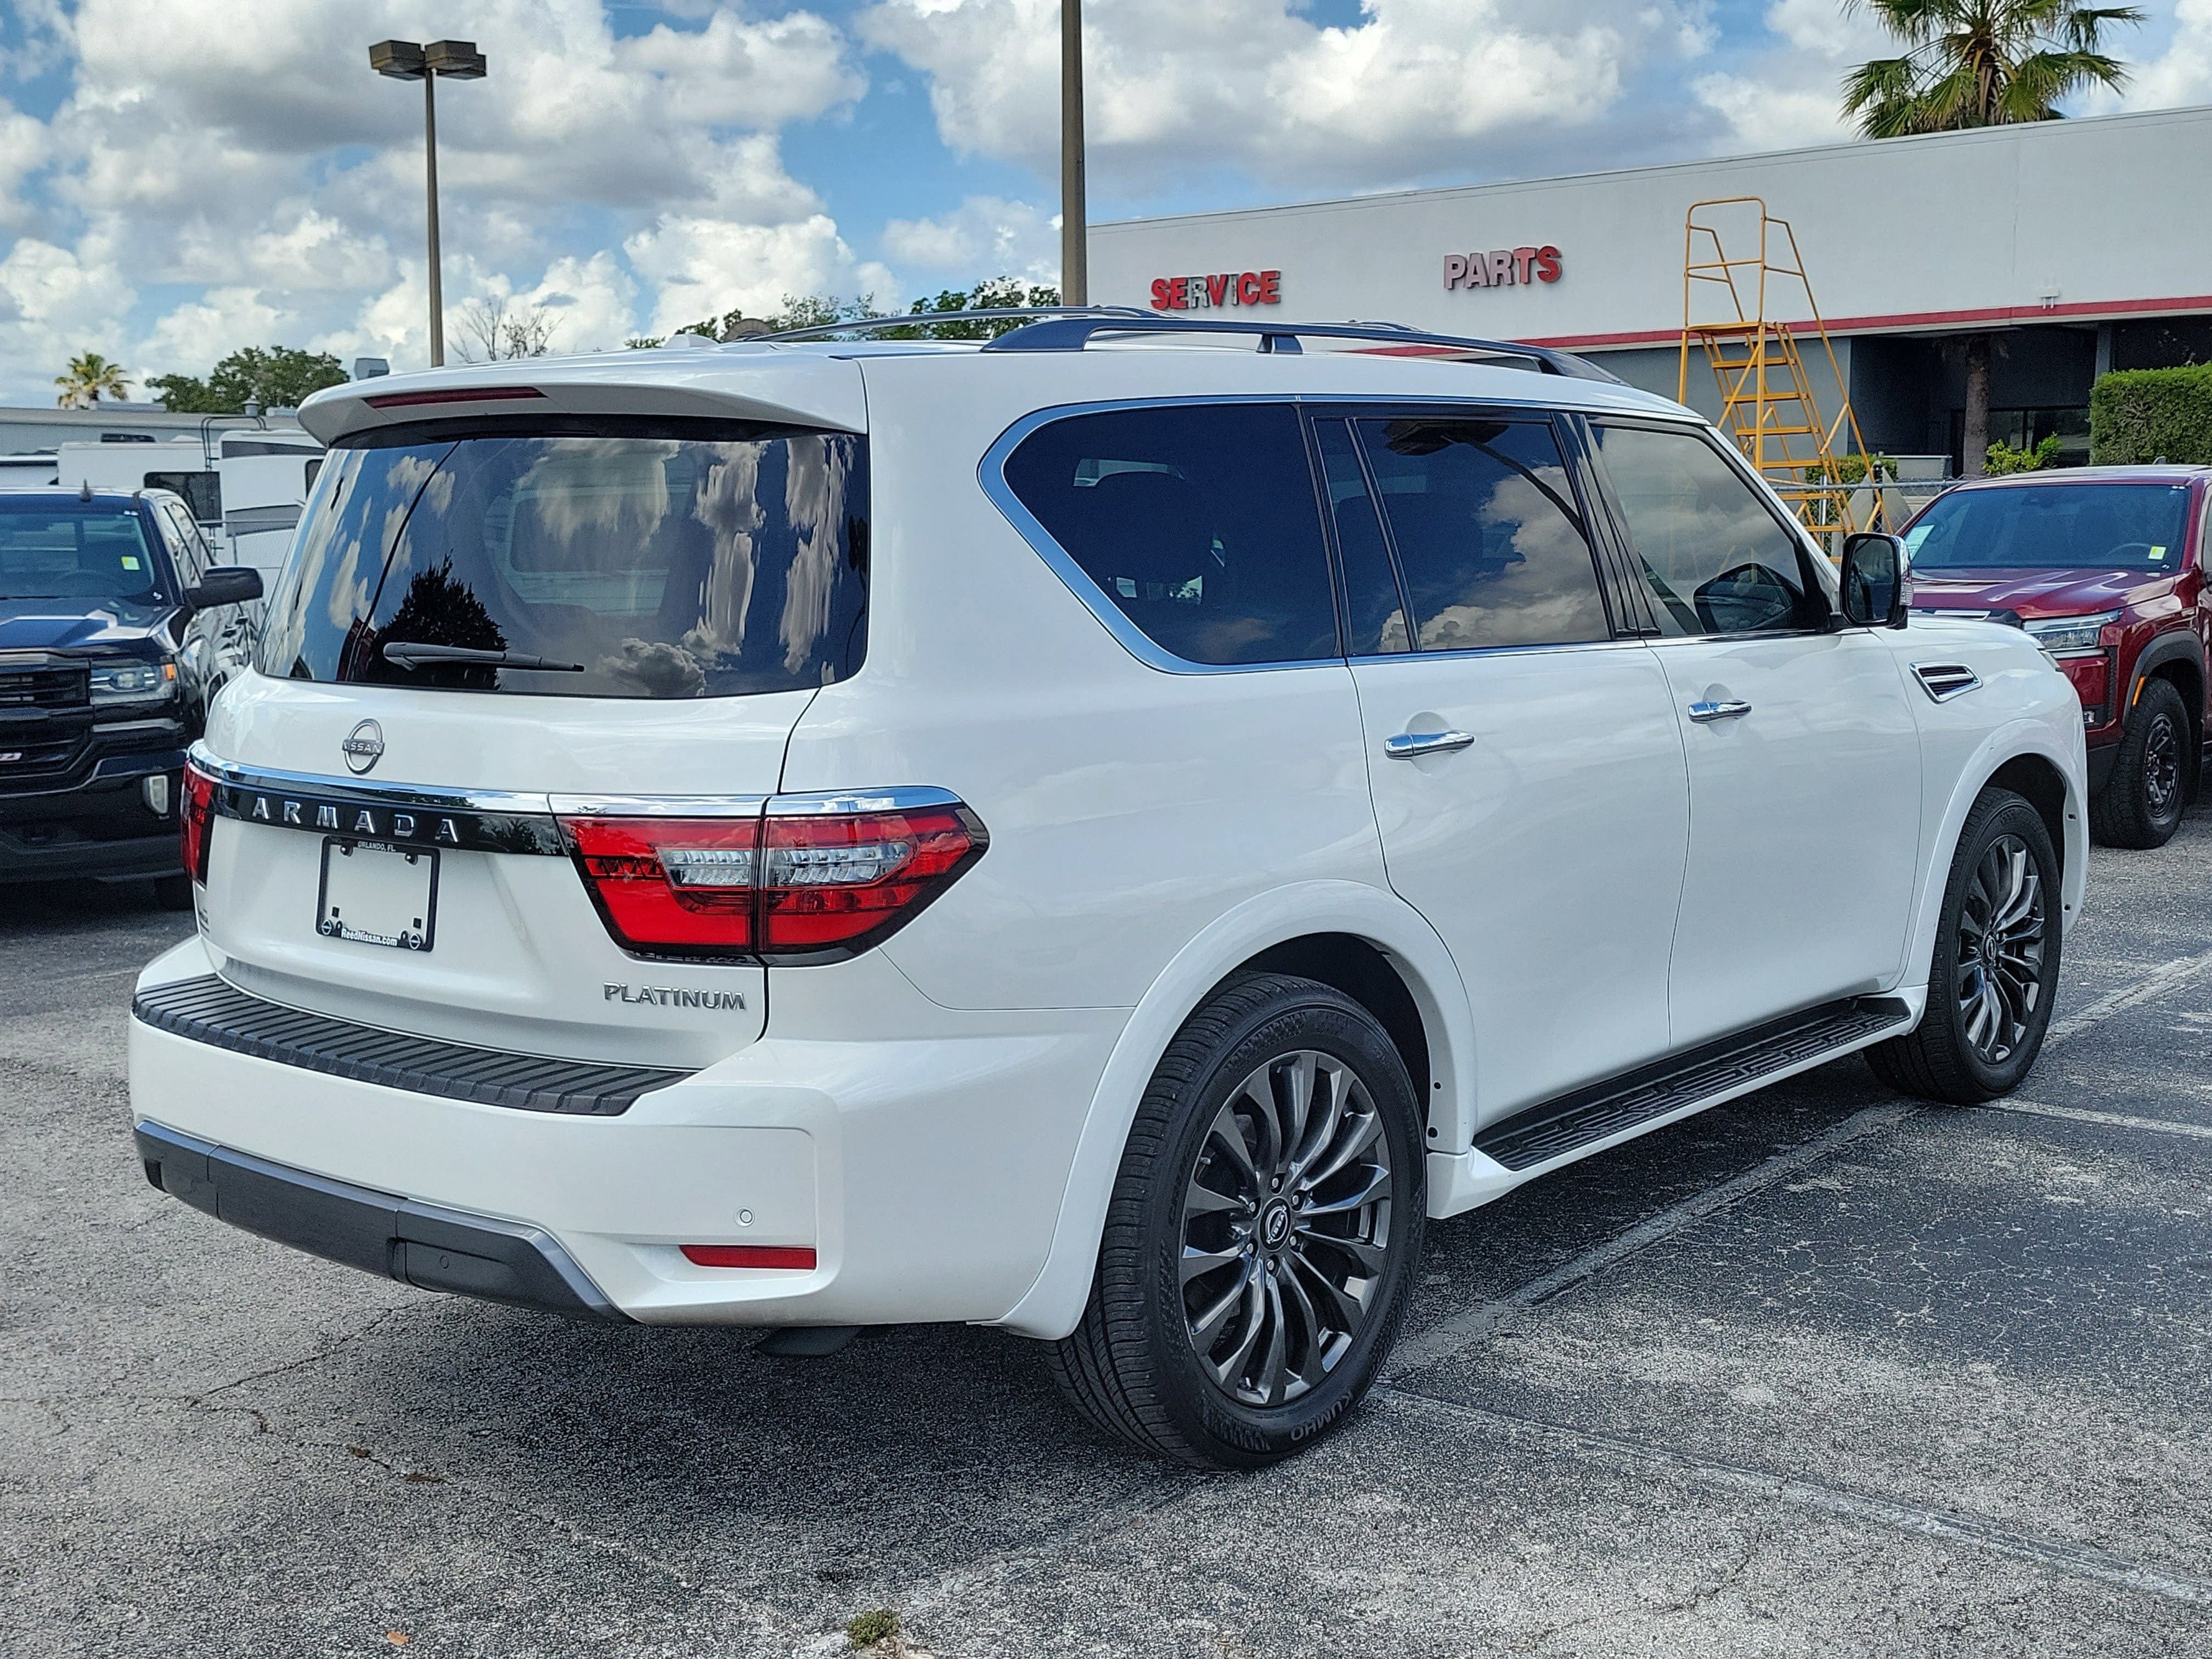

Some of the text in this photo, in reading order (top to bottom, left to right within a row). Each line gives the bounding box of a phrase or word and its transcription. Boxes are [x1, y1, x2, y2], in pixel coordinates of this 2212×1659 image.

[1443, 245, 1562, 289] PARTS
[1150, 270, 1282, 311] SERVICE
[343, 741, 384, 753] NISSAN
[252, 797, 458, 843] ARMADA
[341, 928, 397, 946] ReedNissan.com
[603, 981, 746, 1011] PLATINUM
[1291, 1390, 1352, 1441] KUMHO
